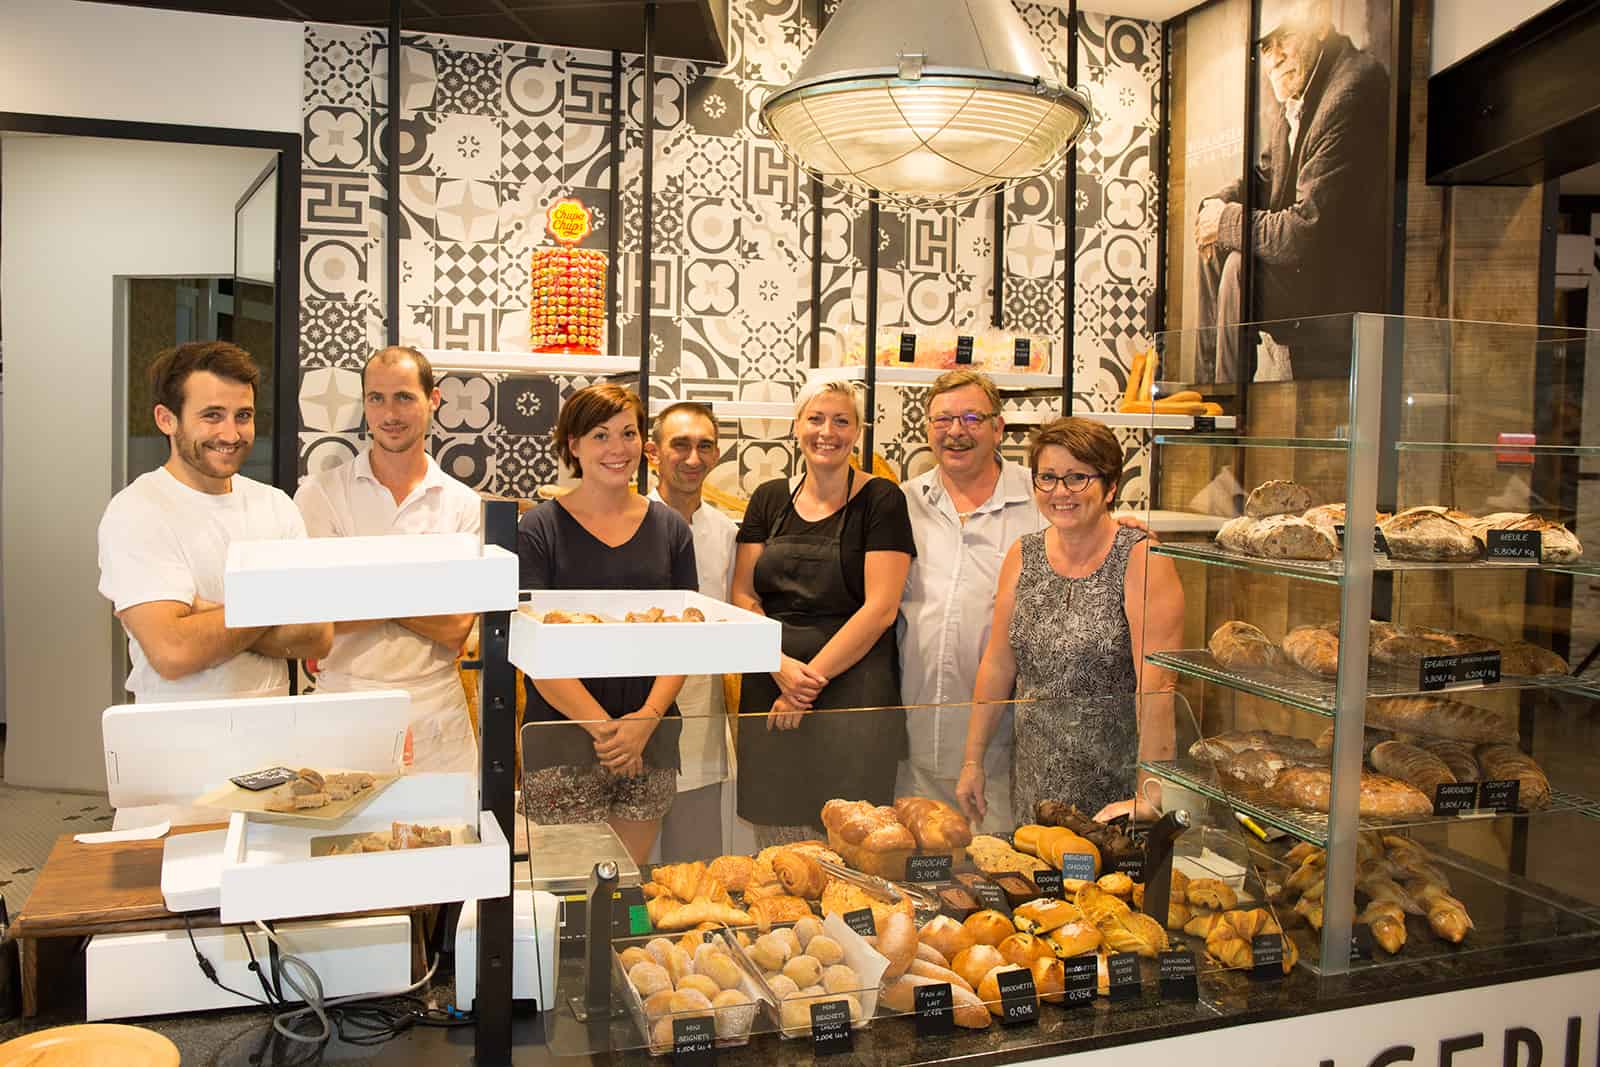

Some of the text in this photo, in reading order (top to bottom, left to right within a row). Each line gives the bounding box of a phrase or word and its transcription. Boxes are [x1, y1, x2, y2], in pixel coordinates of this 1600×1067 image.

[555, 209, 585, 222] Chupa
[553, 220, 583, 233] Chups
[1500, 533, 1529, 542] MEULE
[911, 856, 950, 868] BRIOCHE
[1068, 989, 1092, 1001] 0,95€
[1009, 1004, 1034, 1017] 0,90€
